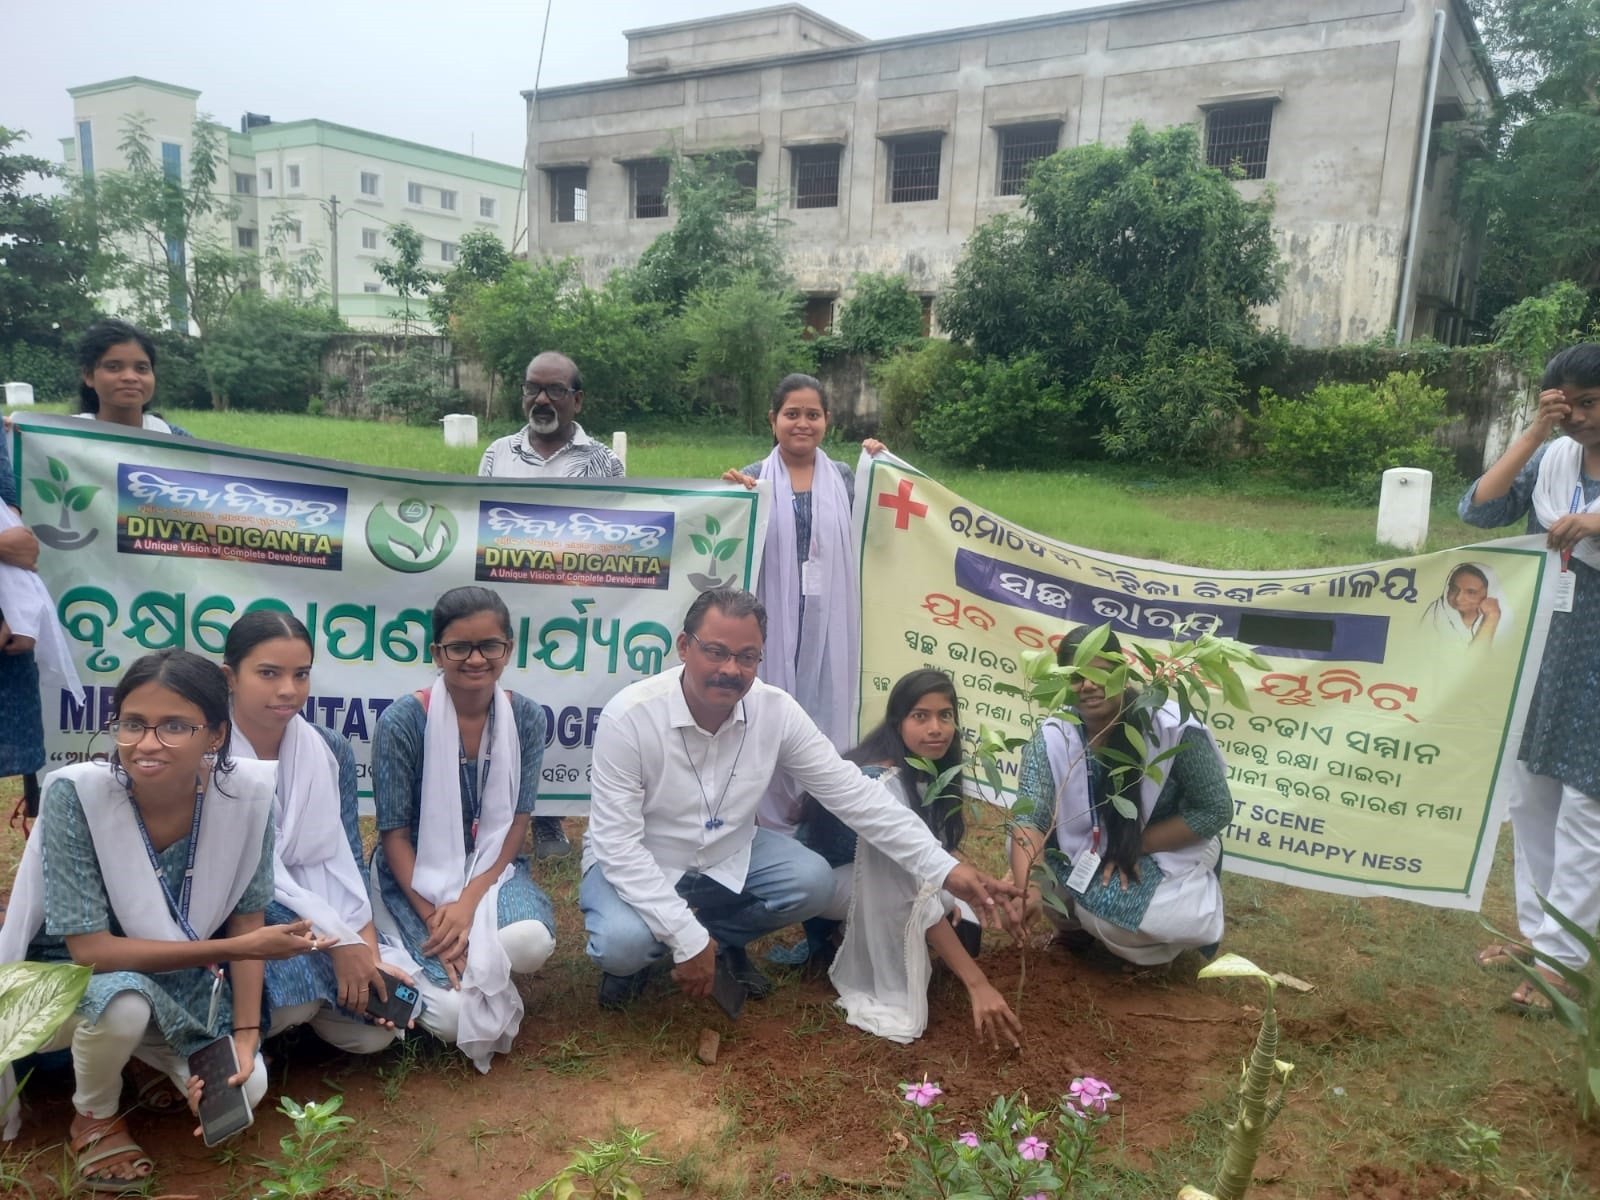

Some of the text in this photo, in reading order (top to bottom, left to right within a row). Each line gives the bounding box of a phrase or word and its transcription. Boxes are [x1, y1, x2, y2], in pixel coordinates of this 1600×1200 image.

[127, 516, 209, 543] DIVYA
[216, 525, 332, 554] DIGANTA
[134, 541, 326, 565] A Unique Vision of Complete Development
[484, 547, 662, 575] DIVYA DIGANTA
[499, 570, 528, 580] Unique
[530, 571, 555, 581] Vision
[557, 572, 565, 580] of
[566, 573, 604, 584] Complete
[605, 575, 656, 586] Development
[947, 642, 1018, 675] ଭାରତ
[1327, 760, 1402, 788] ପାଇବା
[1250, 804, 1326, 835] SCENE
[1340, 791, 1408, 816] କାରଣ
[1416, 803, 1463, 821] ମଶା
[1257, 831, 1272, 848] &
[1278, 835, 1358, 864] HAPPY
[1361, 852, 1423, 873] NESS
